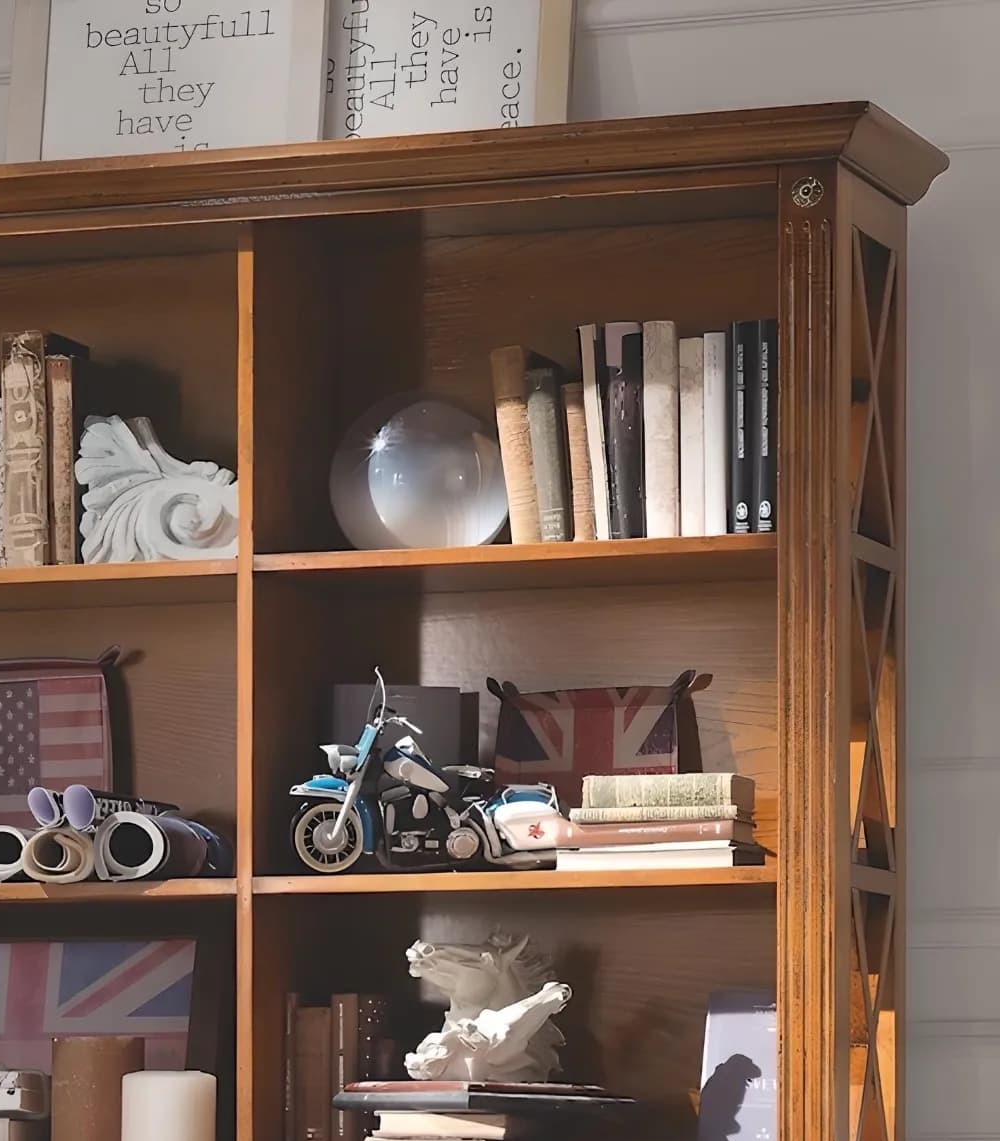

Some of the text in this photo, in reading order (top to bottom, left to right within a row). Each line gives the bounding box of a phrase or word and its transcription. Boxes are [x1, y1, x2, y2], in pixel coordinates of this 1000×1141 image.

[86, 9, 275, 50] beautyfull
[464, 6, 492, 43] is
[119, 46, 177, 76] All
[401, 11, 437, 88] they
[430, 27, 461, 108] have
[138, 77, 216, 108] they
[369, 52, 397, 110] All
[116, 109, 193, 136] have
